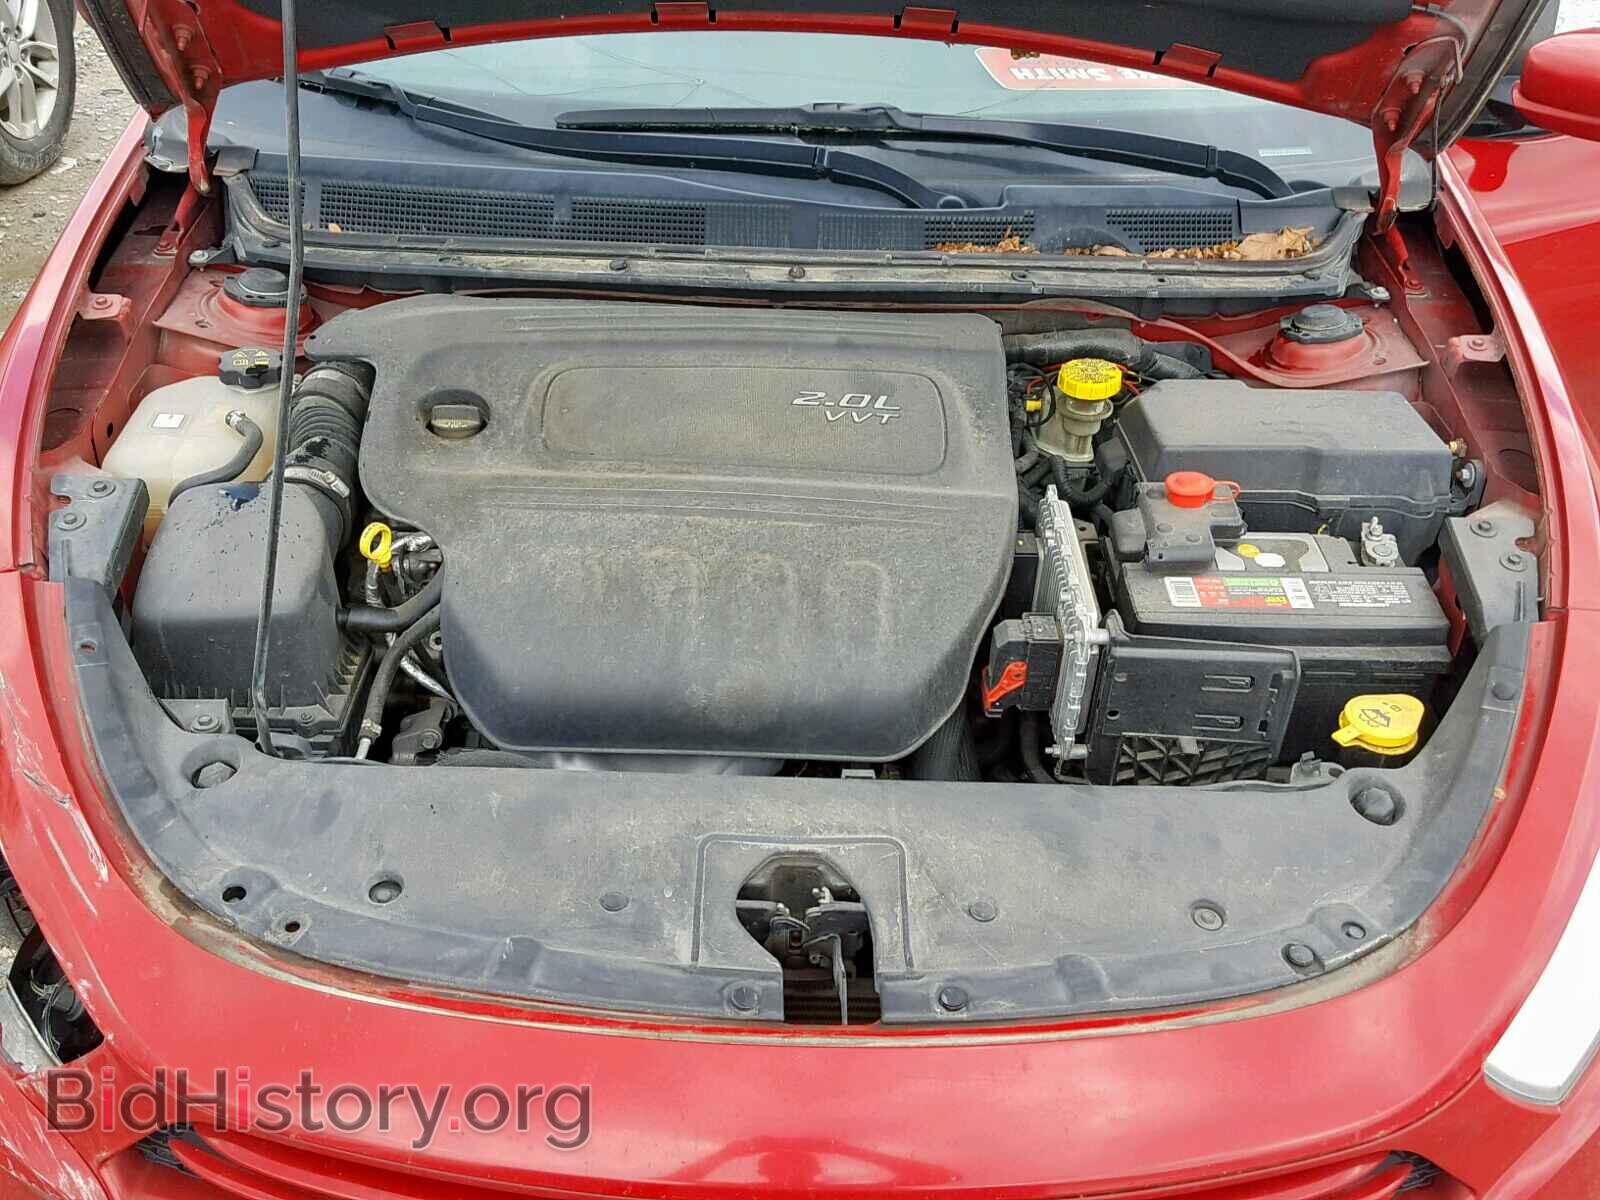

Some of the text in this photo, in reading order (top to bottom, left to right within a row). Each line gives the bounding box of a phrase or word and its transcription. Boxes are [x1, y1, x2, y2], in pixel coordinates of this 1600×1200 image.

[1008, 66, 1112, 81] SMITH
[791, 390, 901, 410] 2.0L
[824, 409, 901, 425] VVT
